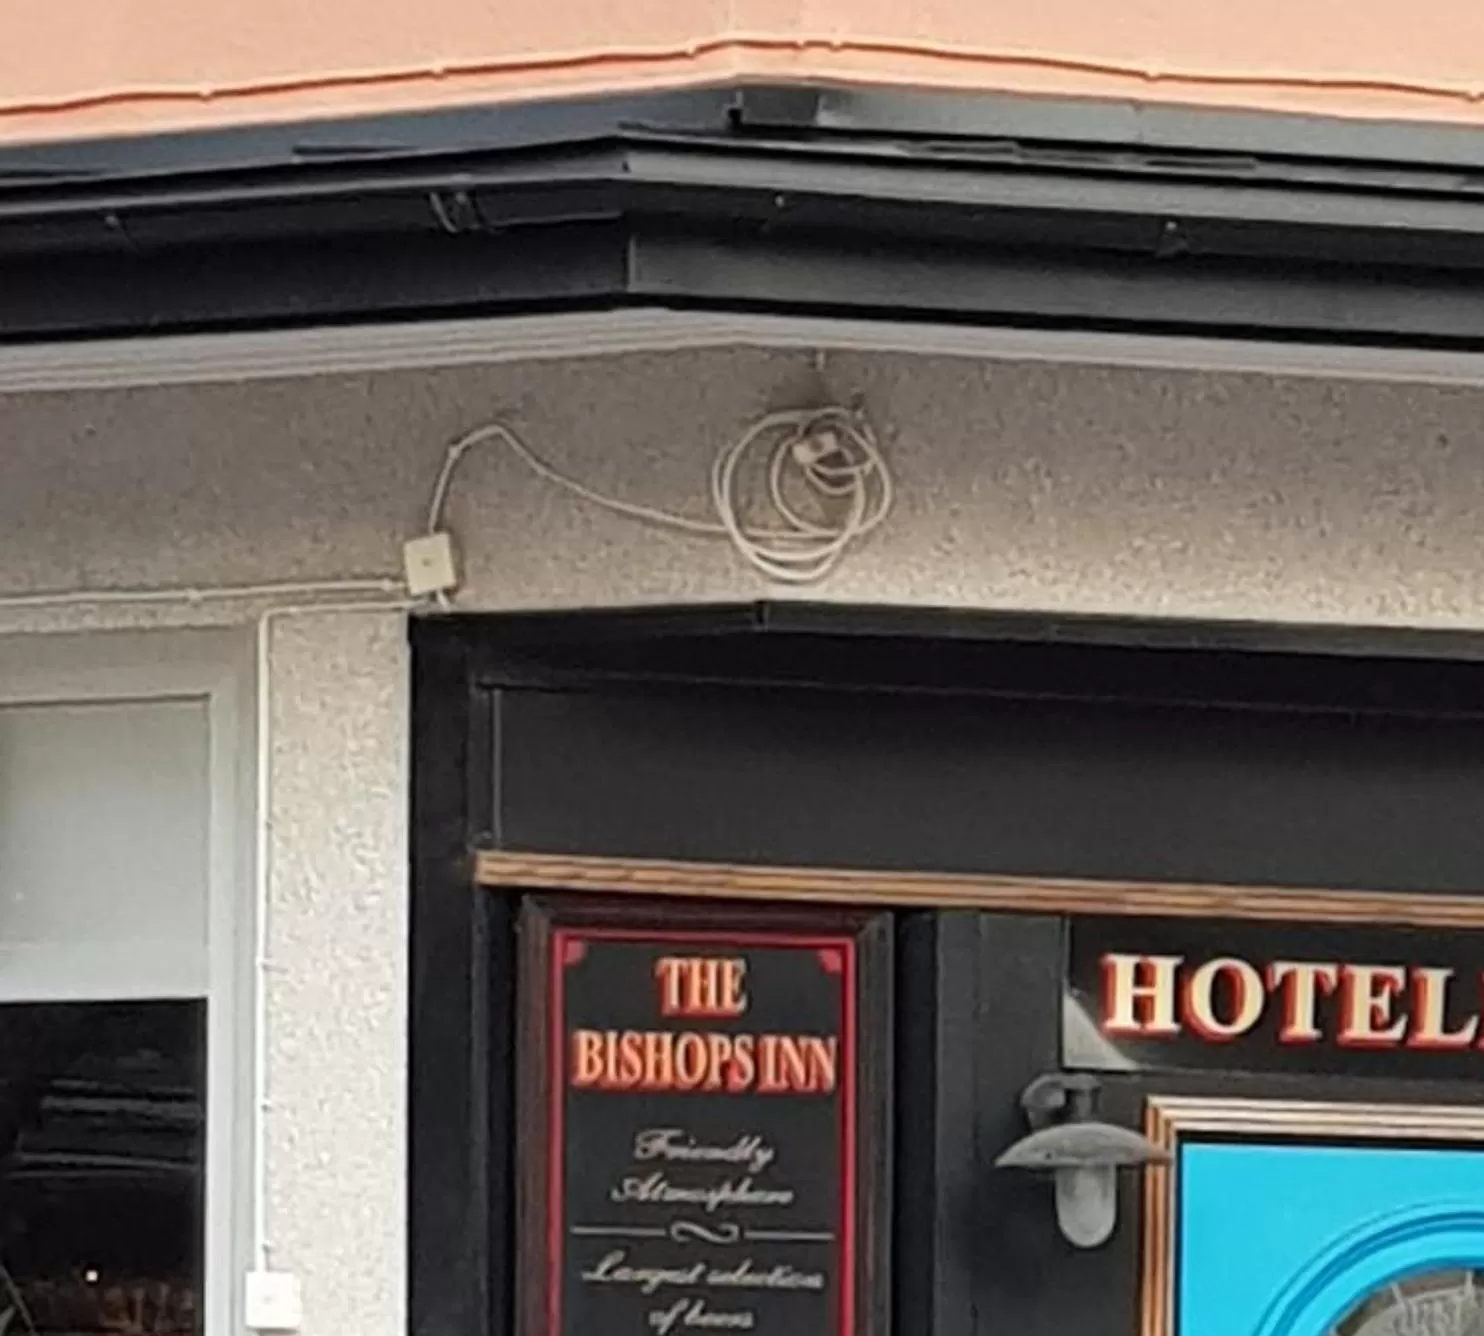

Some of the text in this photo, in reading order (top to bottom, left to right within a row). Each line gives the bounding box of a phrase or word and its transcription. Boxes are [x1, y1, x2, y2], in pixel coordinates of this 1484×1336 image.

[655, 956, 748, 1016] THE
[571, 1028, 837, 1092] BISHOPS INN
[633, 1129, 774, 1171] Friendly
[610, 1172, 794, 1212] Atmosphere
[581, 1251, 823, 1294] Largest selection
[649, 1298, 690, 1336] of
